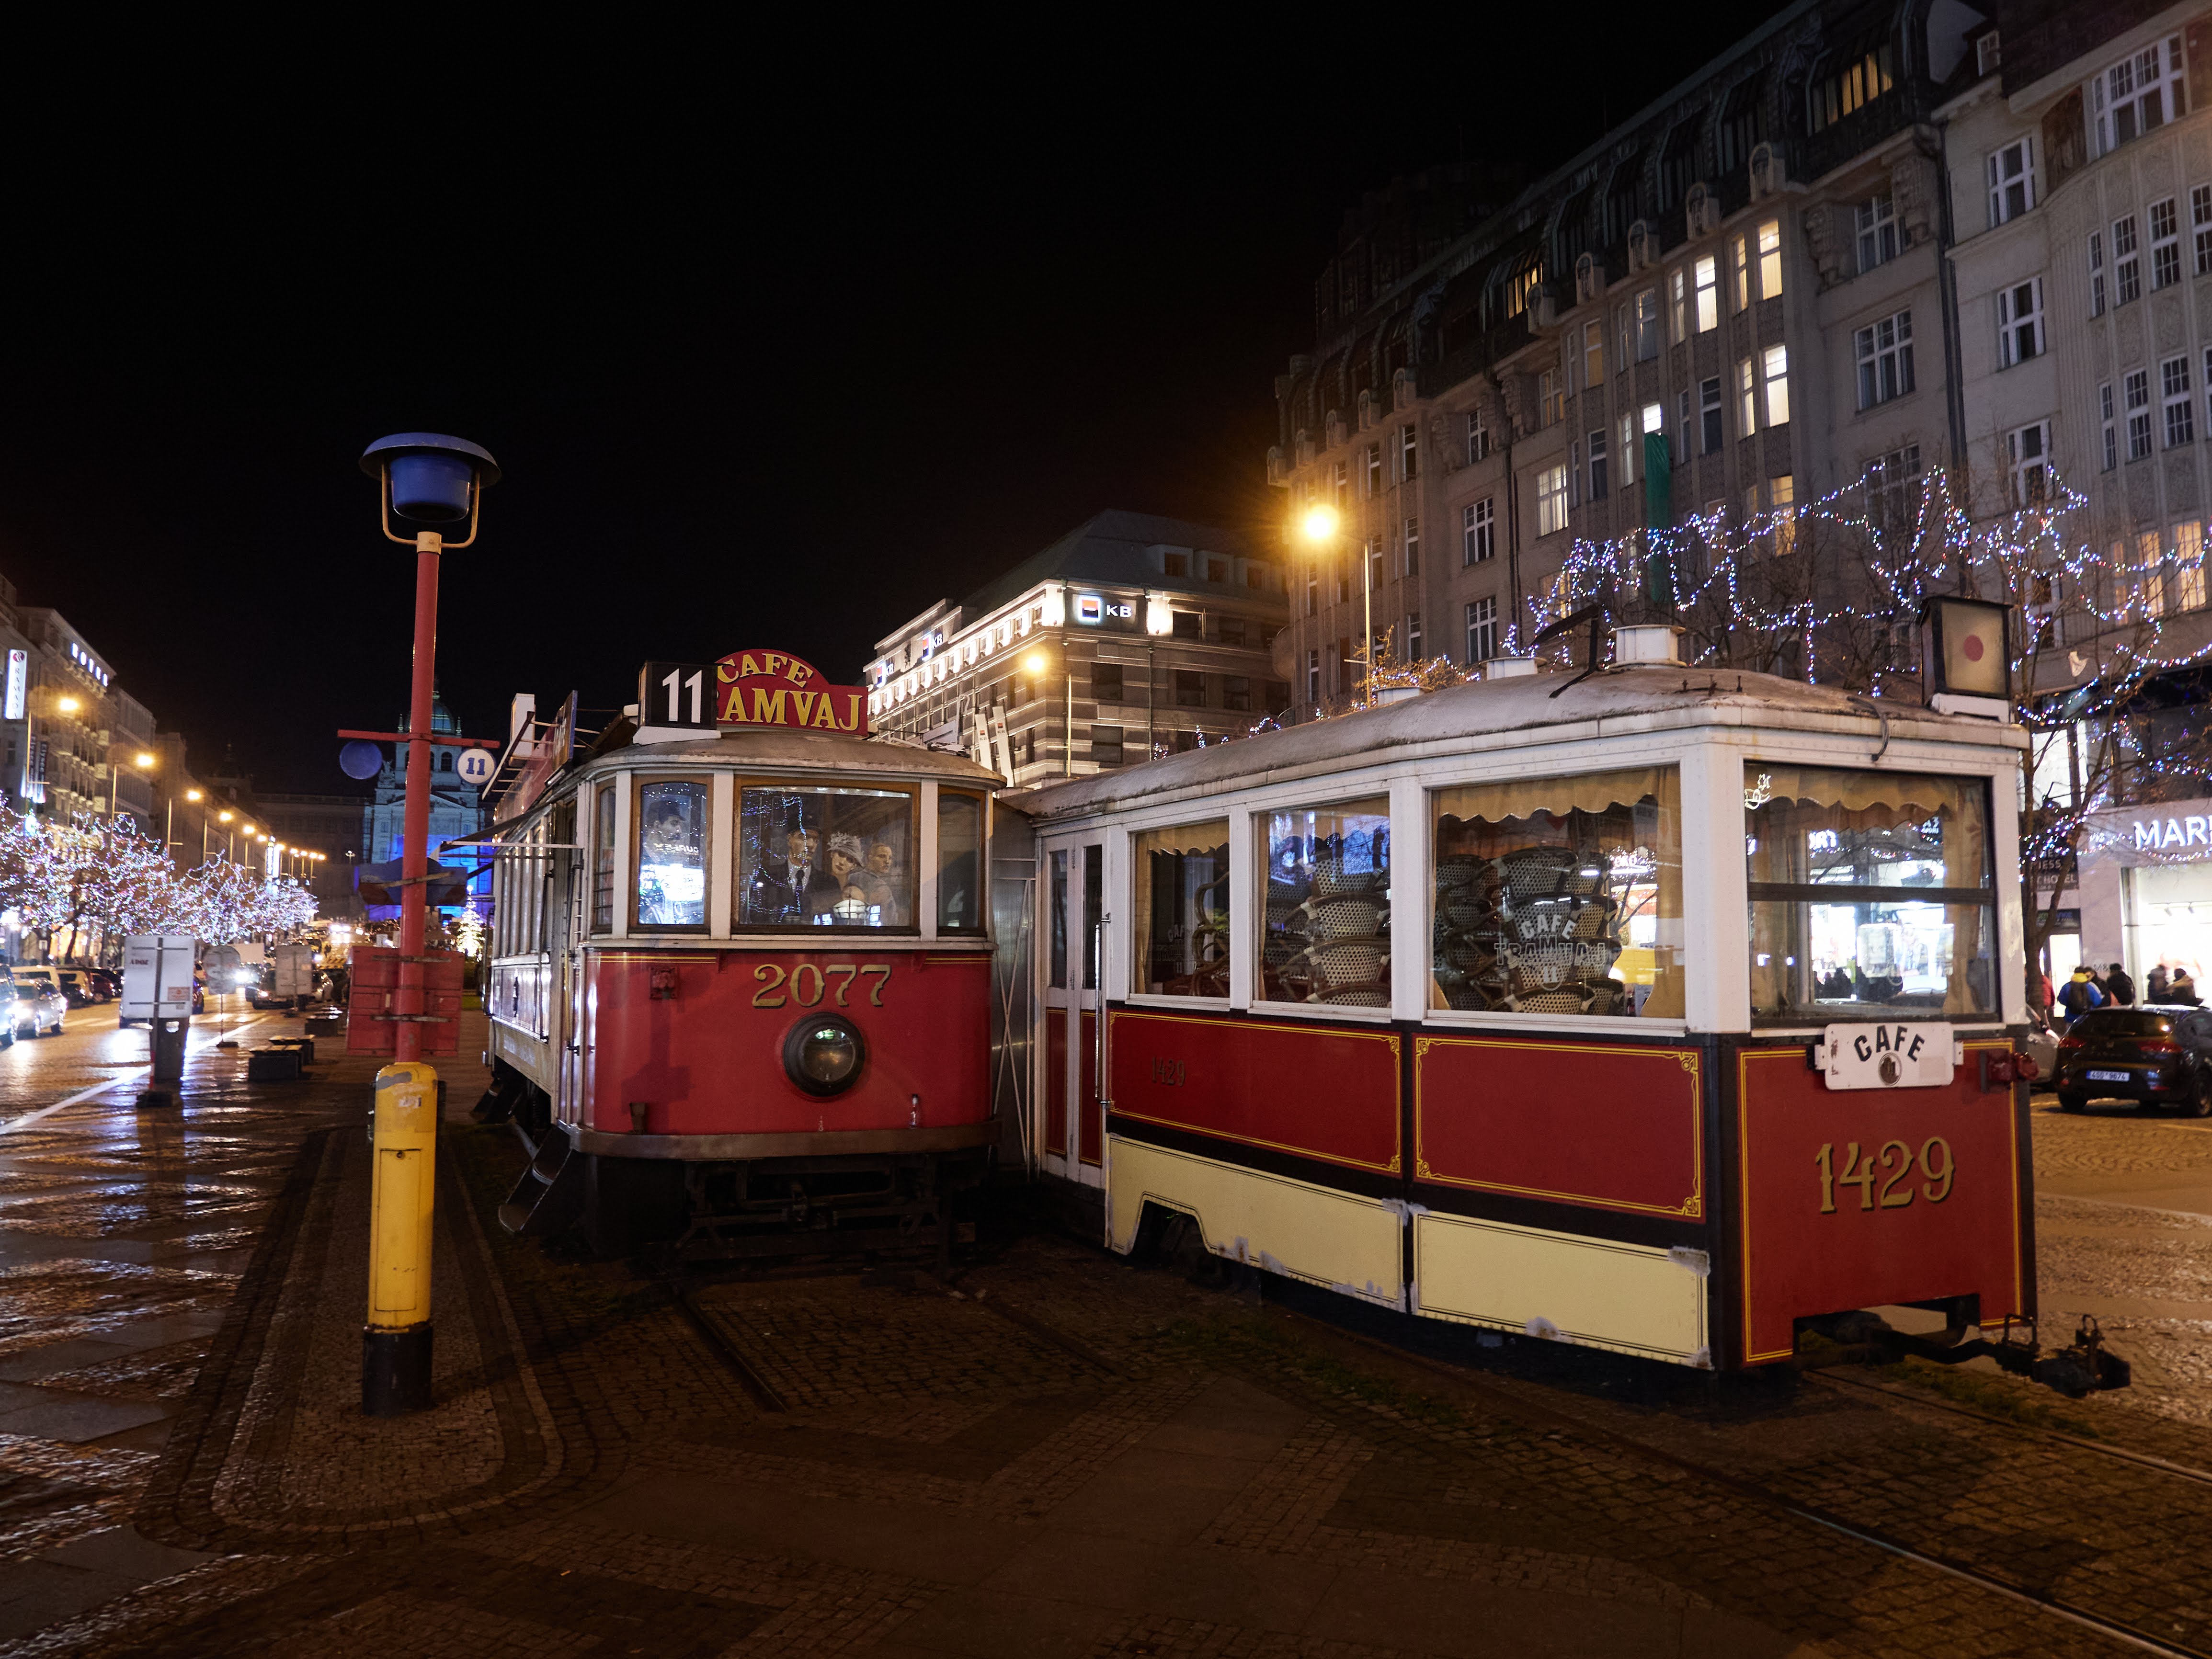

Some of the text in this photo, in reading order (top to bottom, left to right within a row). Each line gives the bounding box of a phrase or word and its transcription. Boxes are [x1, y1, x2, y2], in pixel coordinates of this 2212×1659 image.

[1106, 604, 1132, 618] KB
[934, 634, 943, 648] KB
[717, 653, 813, 688] CAFE
[886, 663, 894, 677] KB
[661, 668, 702, 724] 11
[717, 686, 863, 731] AMVAJ
[466, 757, 485, 775] 11
[2133, 815, 2212, 850] MAR
[1520, 914, 1576, 940] CAFE
[1494, 934, 1606, 966] TRAMVAJ
[752, 963, 892, 1009] 2077
[1854, 1025, 1925, 1062] CAFE
[1152, 1057, 1186, 1087] 1429
[1815, 1136, 1955, 1214] 1429
